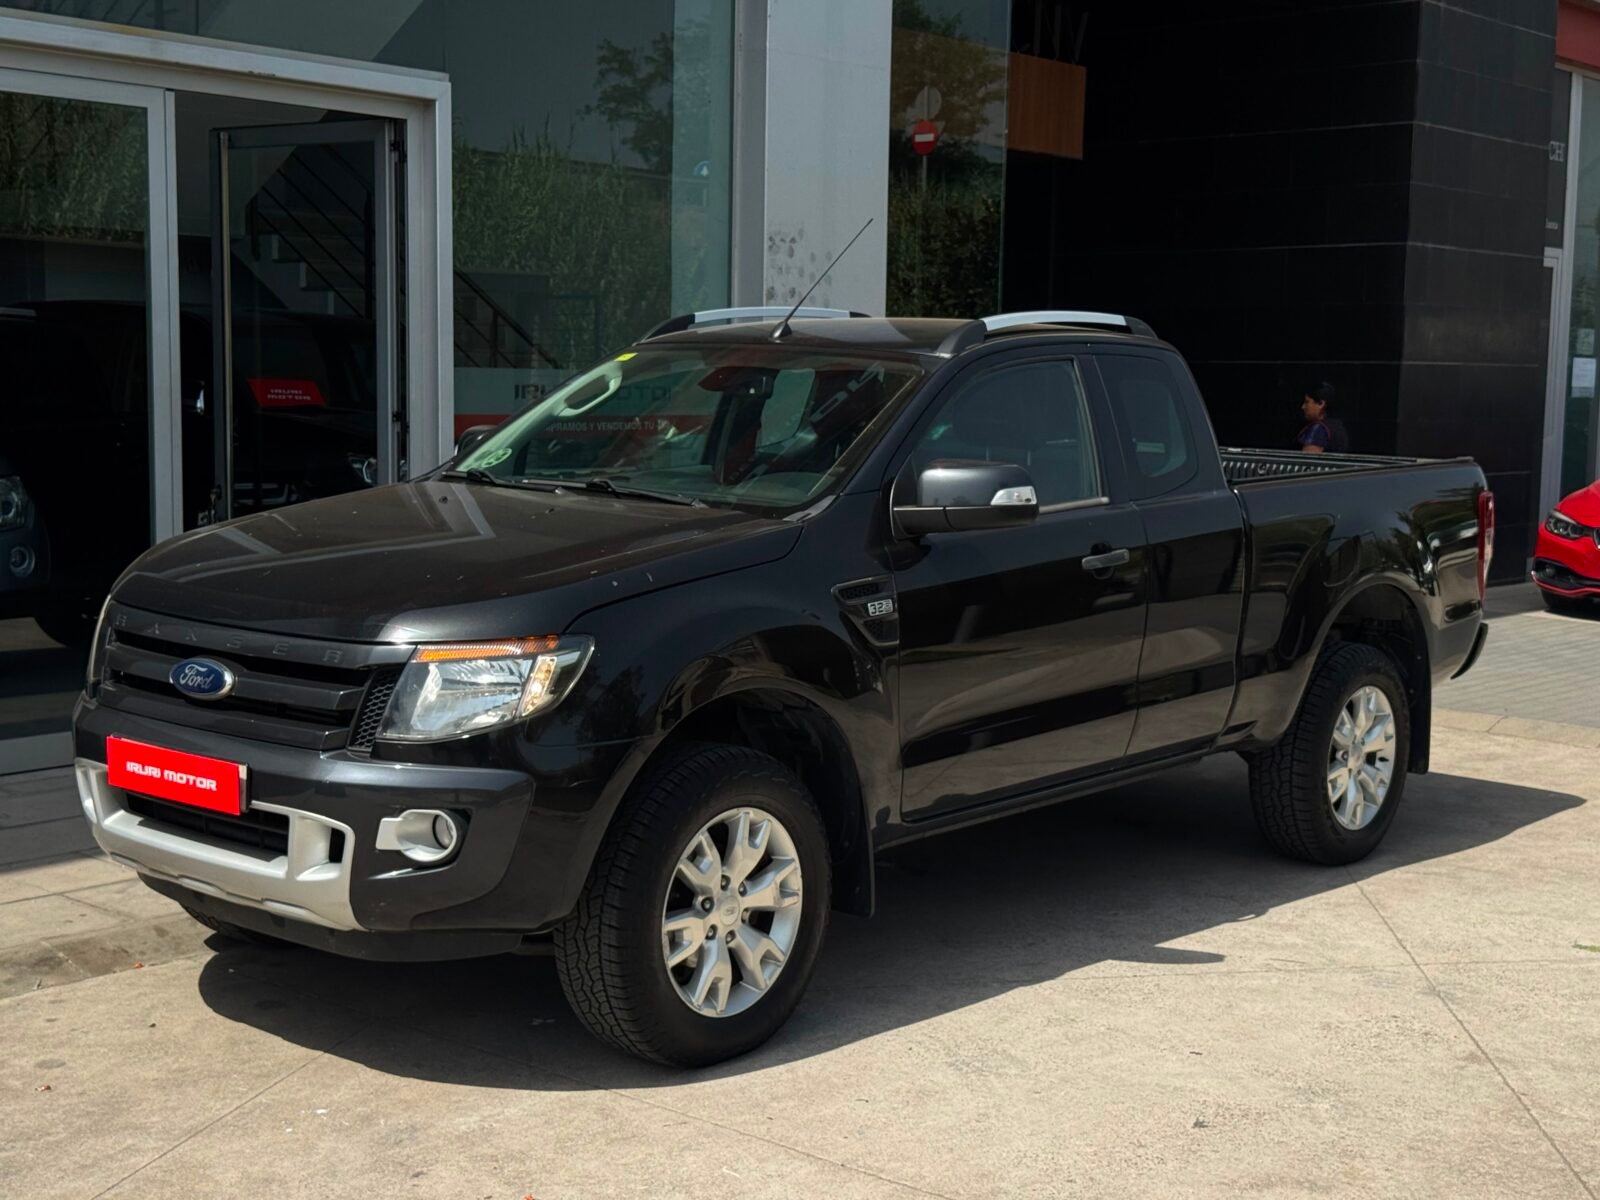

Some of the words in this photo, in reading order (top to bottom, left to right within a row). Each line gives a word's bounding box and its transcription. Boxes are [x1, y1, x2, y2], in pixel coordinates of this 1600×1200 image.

[178, 663, 215, 690] Ford
[125, 760, 161, 779] IRURI
[164, 769, 218, 791] MOTOR
